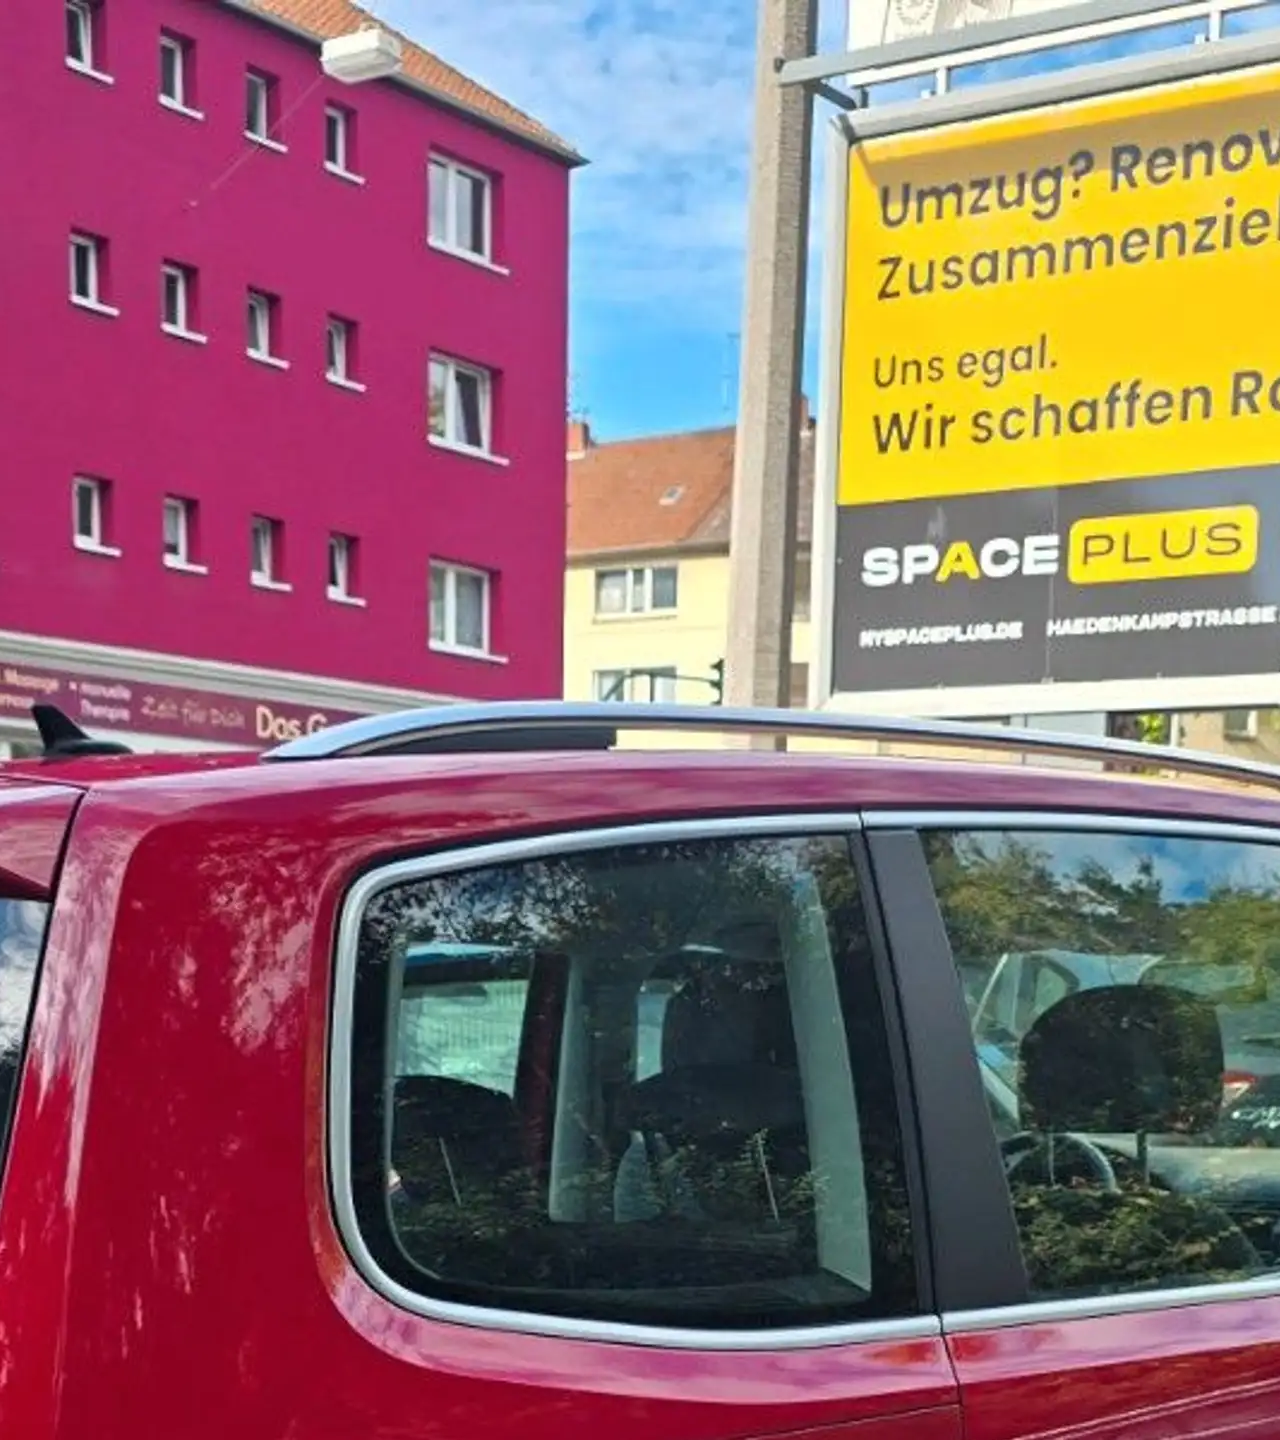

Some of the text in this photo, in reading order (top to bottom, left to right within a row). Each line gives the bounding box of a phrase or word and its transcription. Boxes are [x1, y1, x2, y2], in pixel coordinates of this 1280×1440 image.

[881, 150, 1094, 227] Umzug?
[873, 333, 1058, 388] Uns egal.
[872, 403, 957, 454] Wir
[970, 379, 1213, 444] schaffen
[860, 522, 1243, 587] SPACE PLUS
[255, 704, 301, 740] Das
